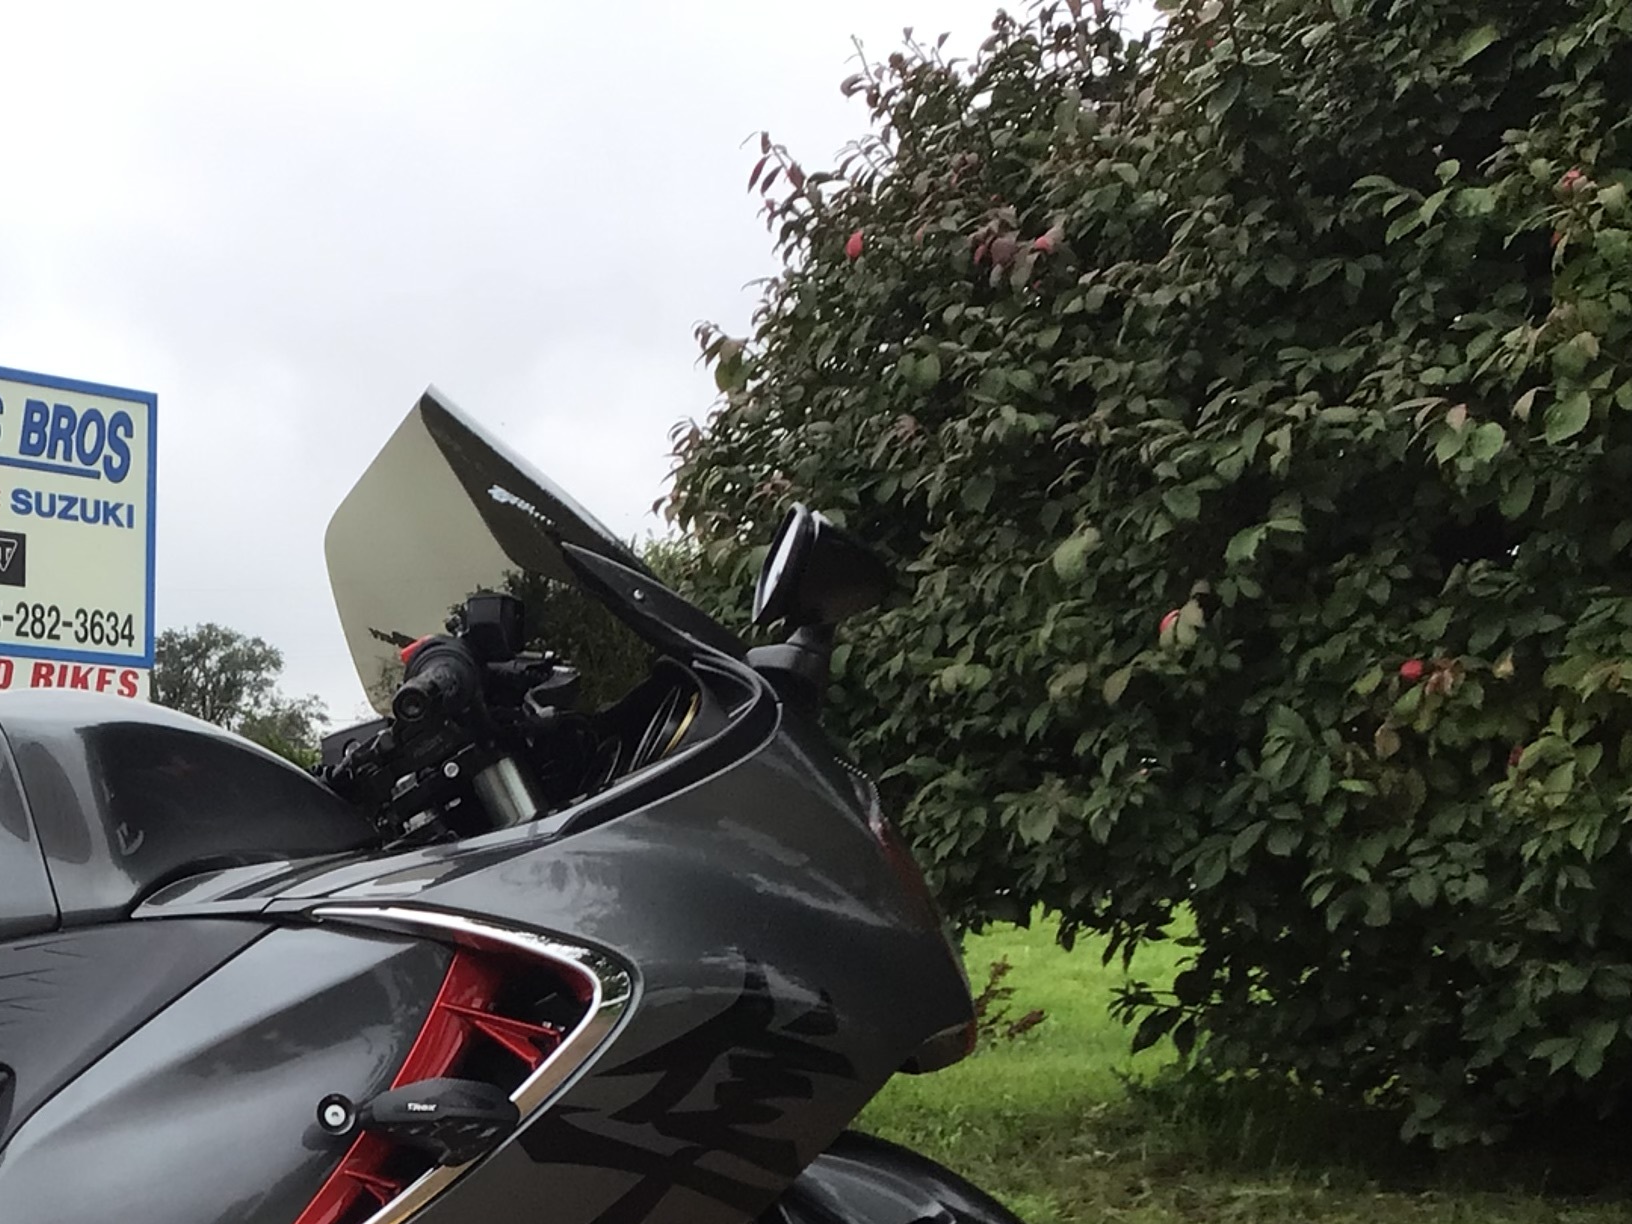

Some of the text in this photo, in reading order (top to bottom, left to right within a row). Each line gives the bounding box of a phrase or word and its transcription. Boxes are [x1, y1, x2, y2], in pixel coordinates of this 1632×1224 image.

[19, 398, 134, 483] BROS
[11, 488, 135, 528] SUZUKI
[31, 663, 139, 698] BIKES
